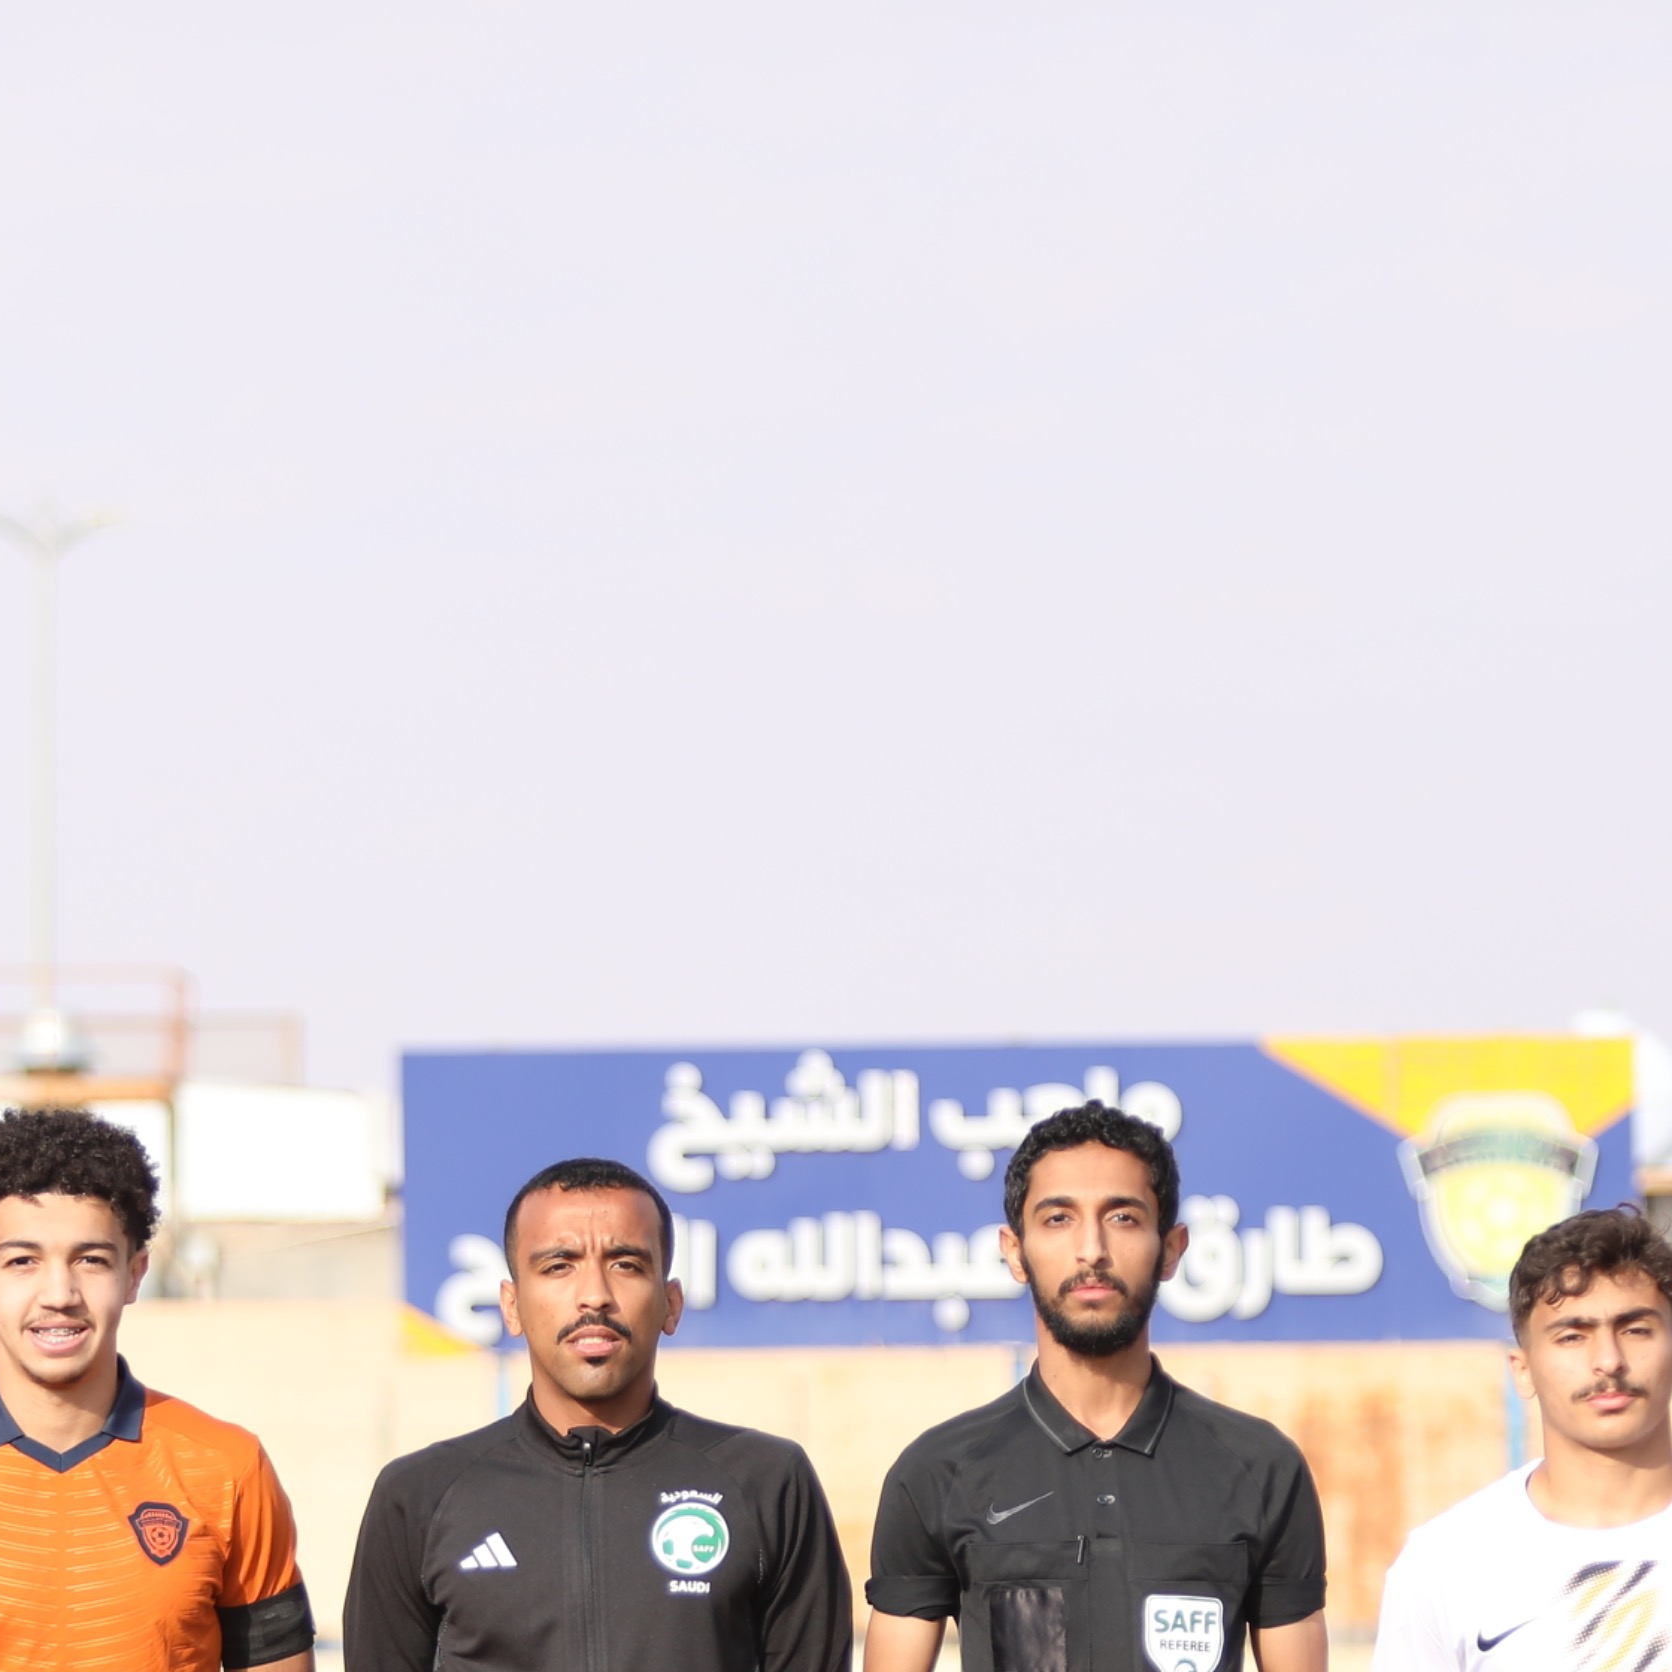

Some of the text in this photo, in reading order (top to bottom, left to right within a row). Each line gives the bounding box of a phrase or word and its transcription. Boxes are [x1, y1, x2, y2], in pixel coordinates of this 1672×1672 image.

[646, 1048, 920, 1194] الشيخ
[1158, 1193, 1384, 1323] طارق
[727, 1209, 1028, 1333] عبدالله
[660, 1490, 724, 1505] السعودية
[693, 1544, 715, 1553] SAFF
[669, 1580, 711, 1594] SAUDI
[1154, 1609, 1217, 1634] SAFF
[1159, 1639, 1211, 1652] REFEREE
